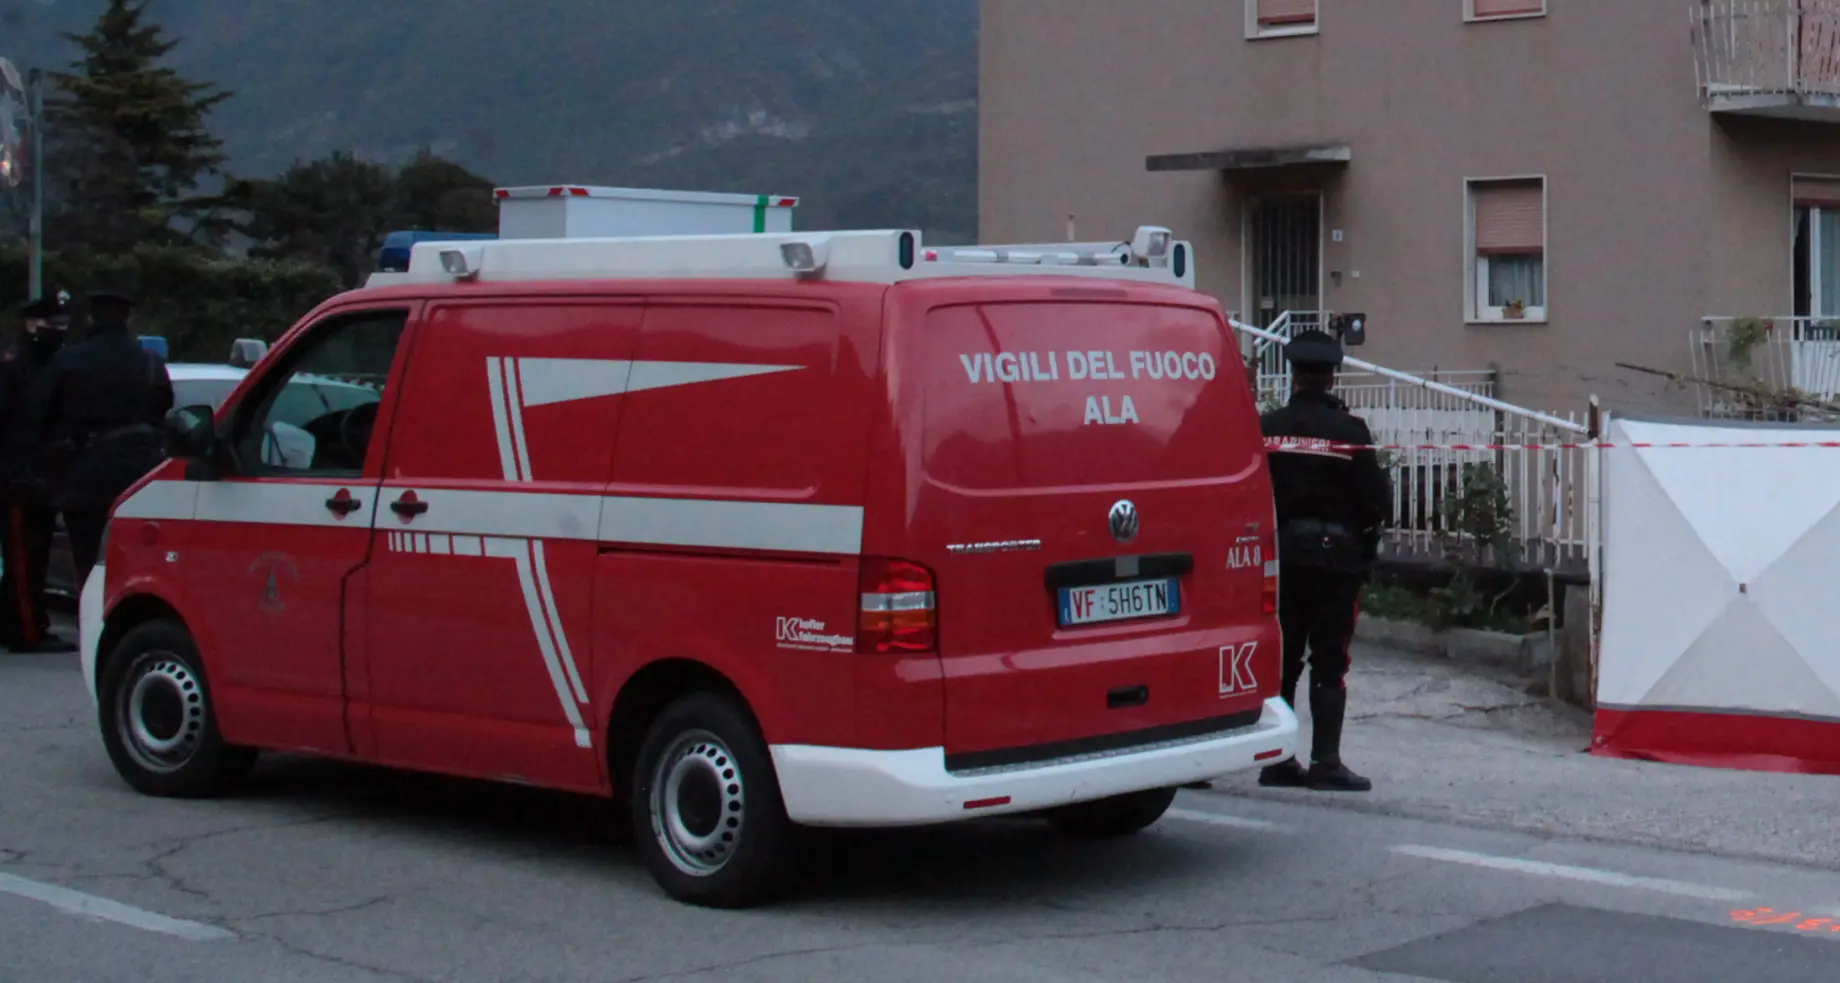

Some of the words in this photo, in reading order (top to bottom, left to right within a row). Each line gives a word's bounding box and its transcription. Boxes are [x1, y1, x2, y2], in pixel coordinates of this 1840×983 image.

[960, 351, 1059, 383] VIGILI
[1066, 350, 1125, 381] DEL
[1129, 351, 1216, 382] FUOCO
[1083, 395, 1140, 426] ALA
[1225, 547, 1251, 569] ALA
[1072, 589, 1096, 619] VF
[1108, 583, 1168, 615] 5H6TN
[1219, 641, 1258, 694] K
